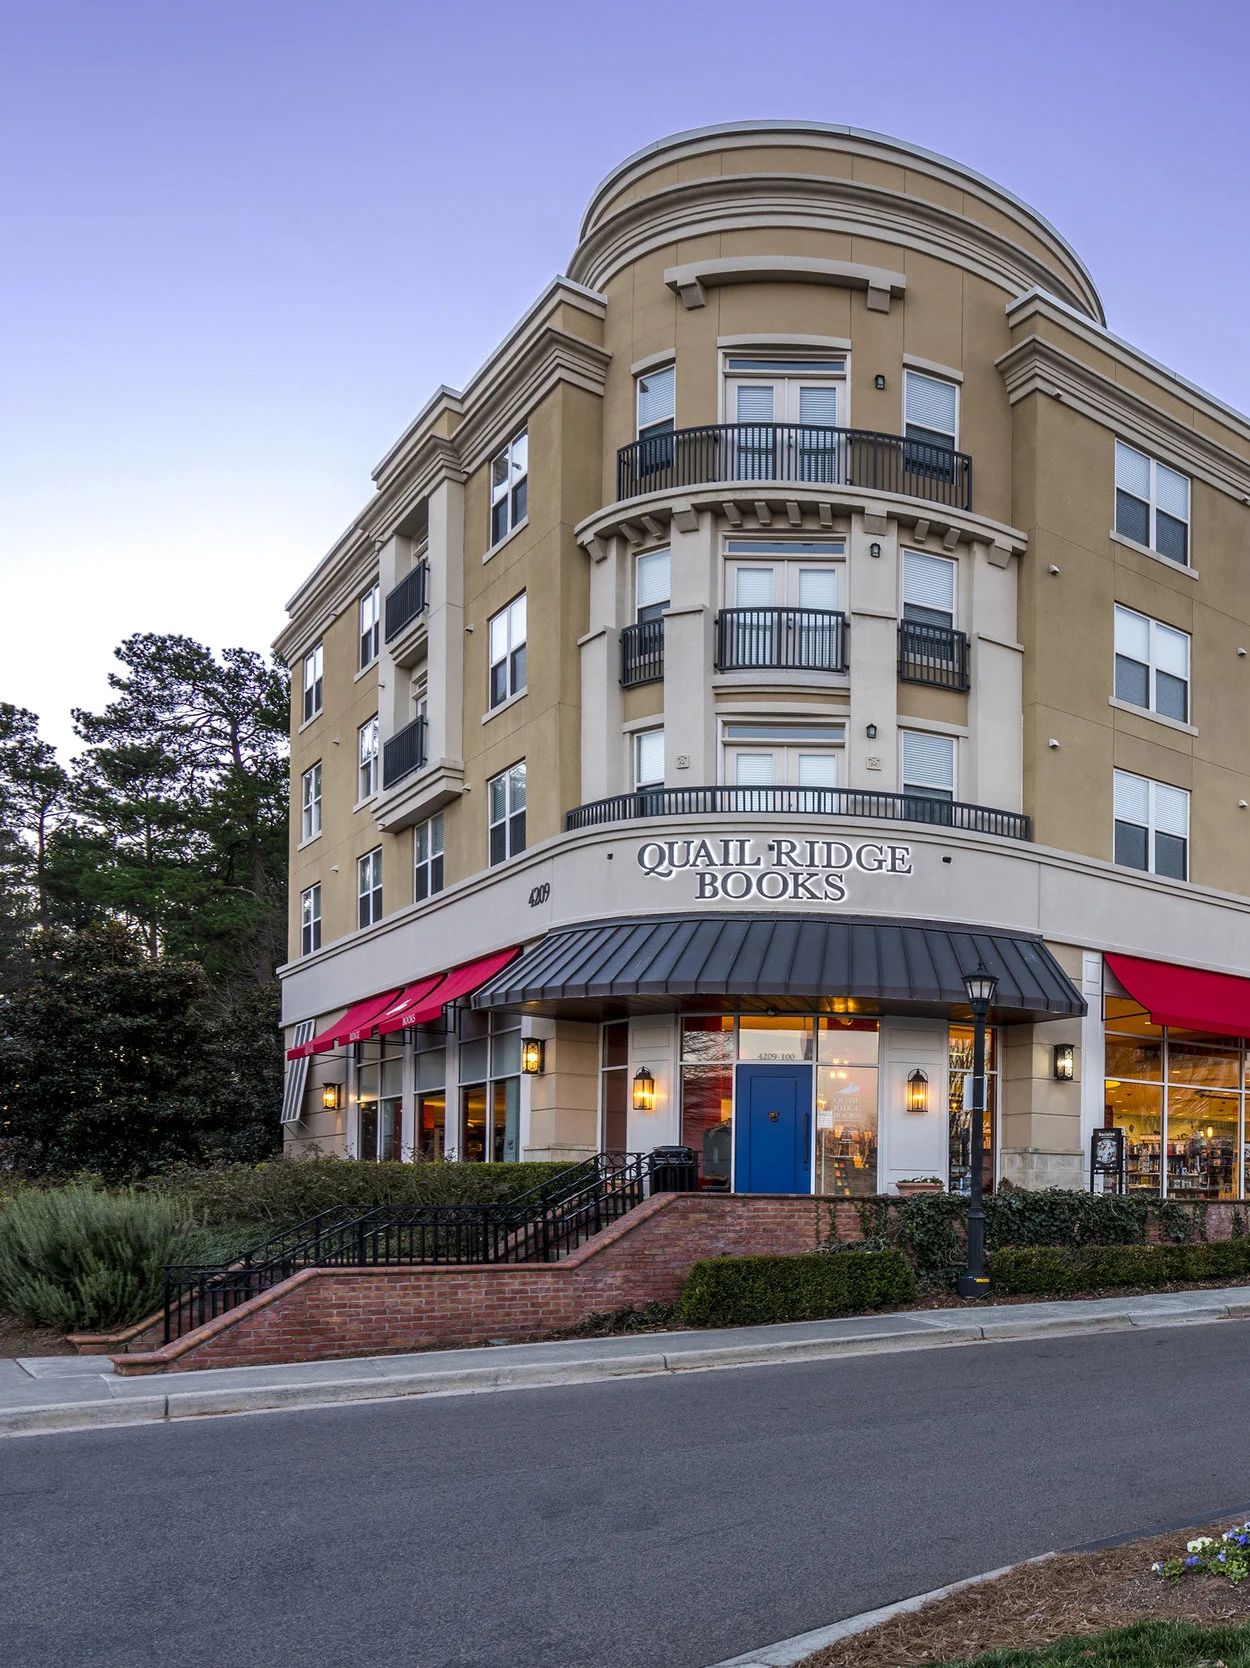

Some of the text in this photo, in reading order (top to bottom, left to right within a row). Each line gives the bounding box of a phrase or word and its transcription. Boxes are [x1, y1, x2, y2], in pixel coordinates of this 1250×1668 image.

[637, 839, 912, 877] QUAIL RIDGE
[528, 882, 550, 907] 4209
[695, 871, 846, 901] BOOKS
[402, 1014, 416, 1026] BOOKS
